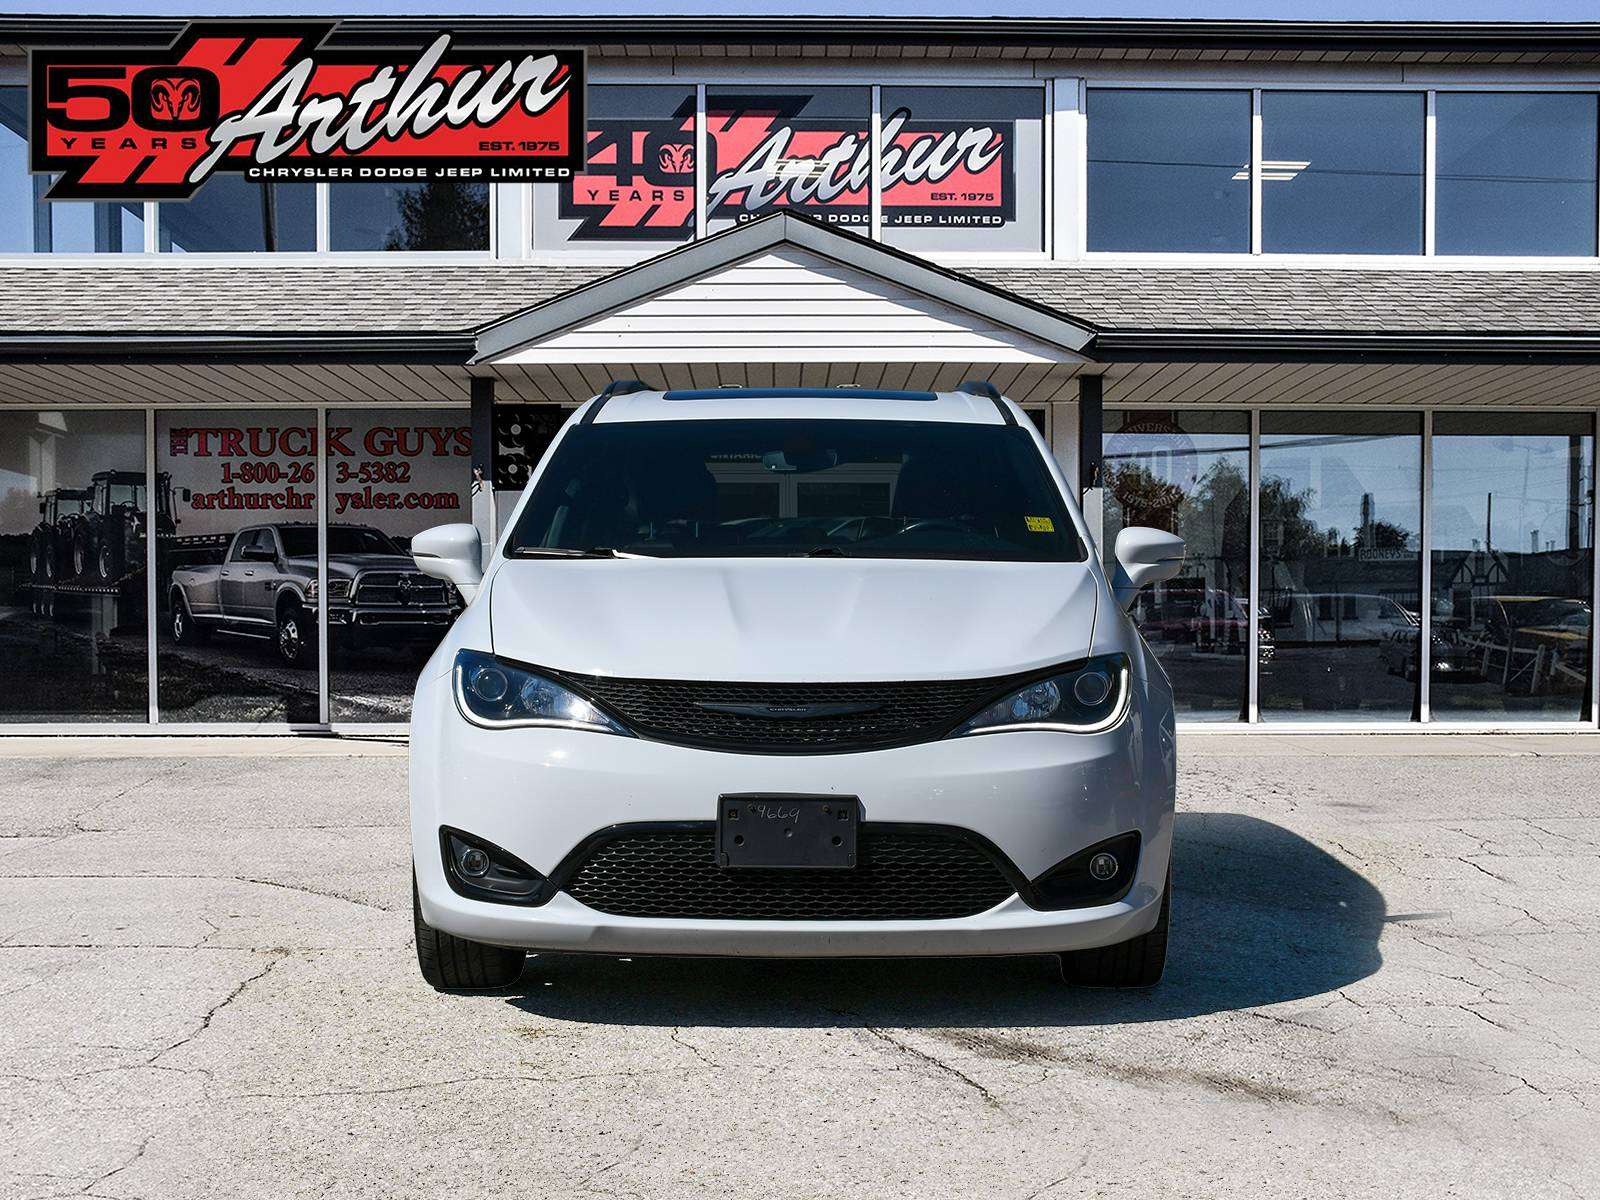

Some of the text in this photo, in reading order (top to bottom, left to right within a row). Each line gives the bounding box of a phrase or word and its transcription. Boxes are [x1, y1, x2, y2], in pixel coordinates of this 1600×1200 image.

[587, 131, 717, 187] 40
[688, 112, 1004, 227] Arthur
[587, 189, 685, 201] YEARS
[930, 192, 994, 201] EST. 1975
[894, 214, 933, 224] JEEP
[939, 214, 1002, 225] LIMITED
[190, 427, 472, 458] TRUCK GUYS
